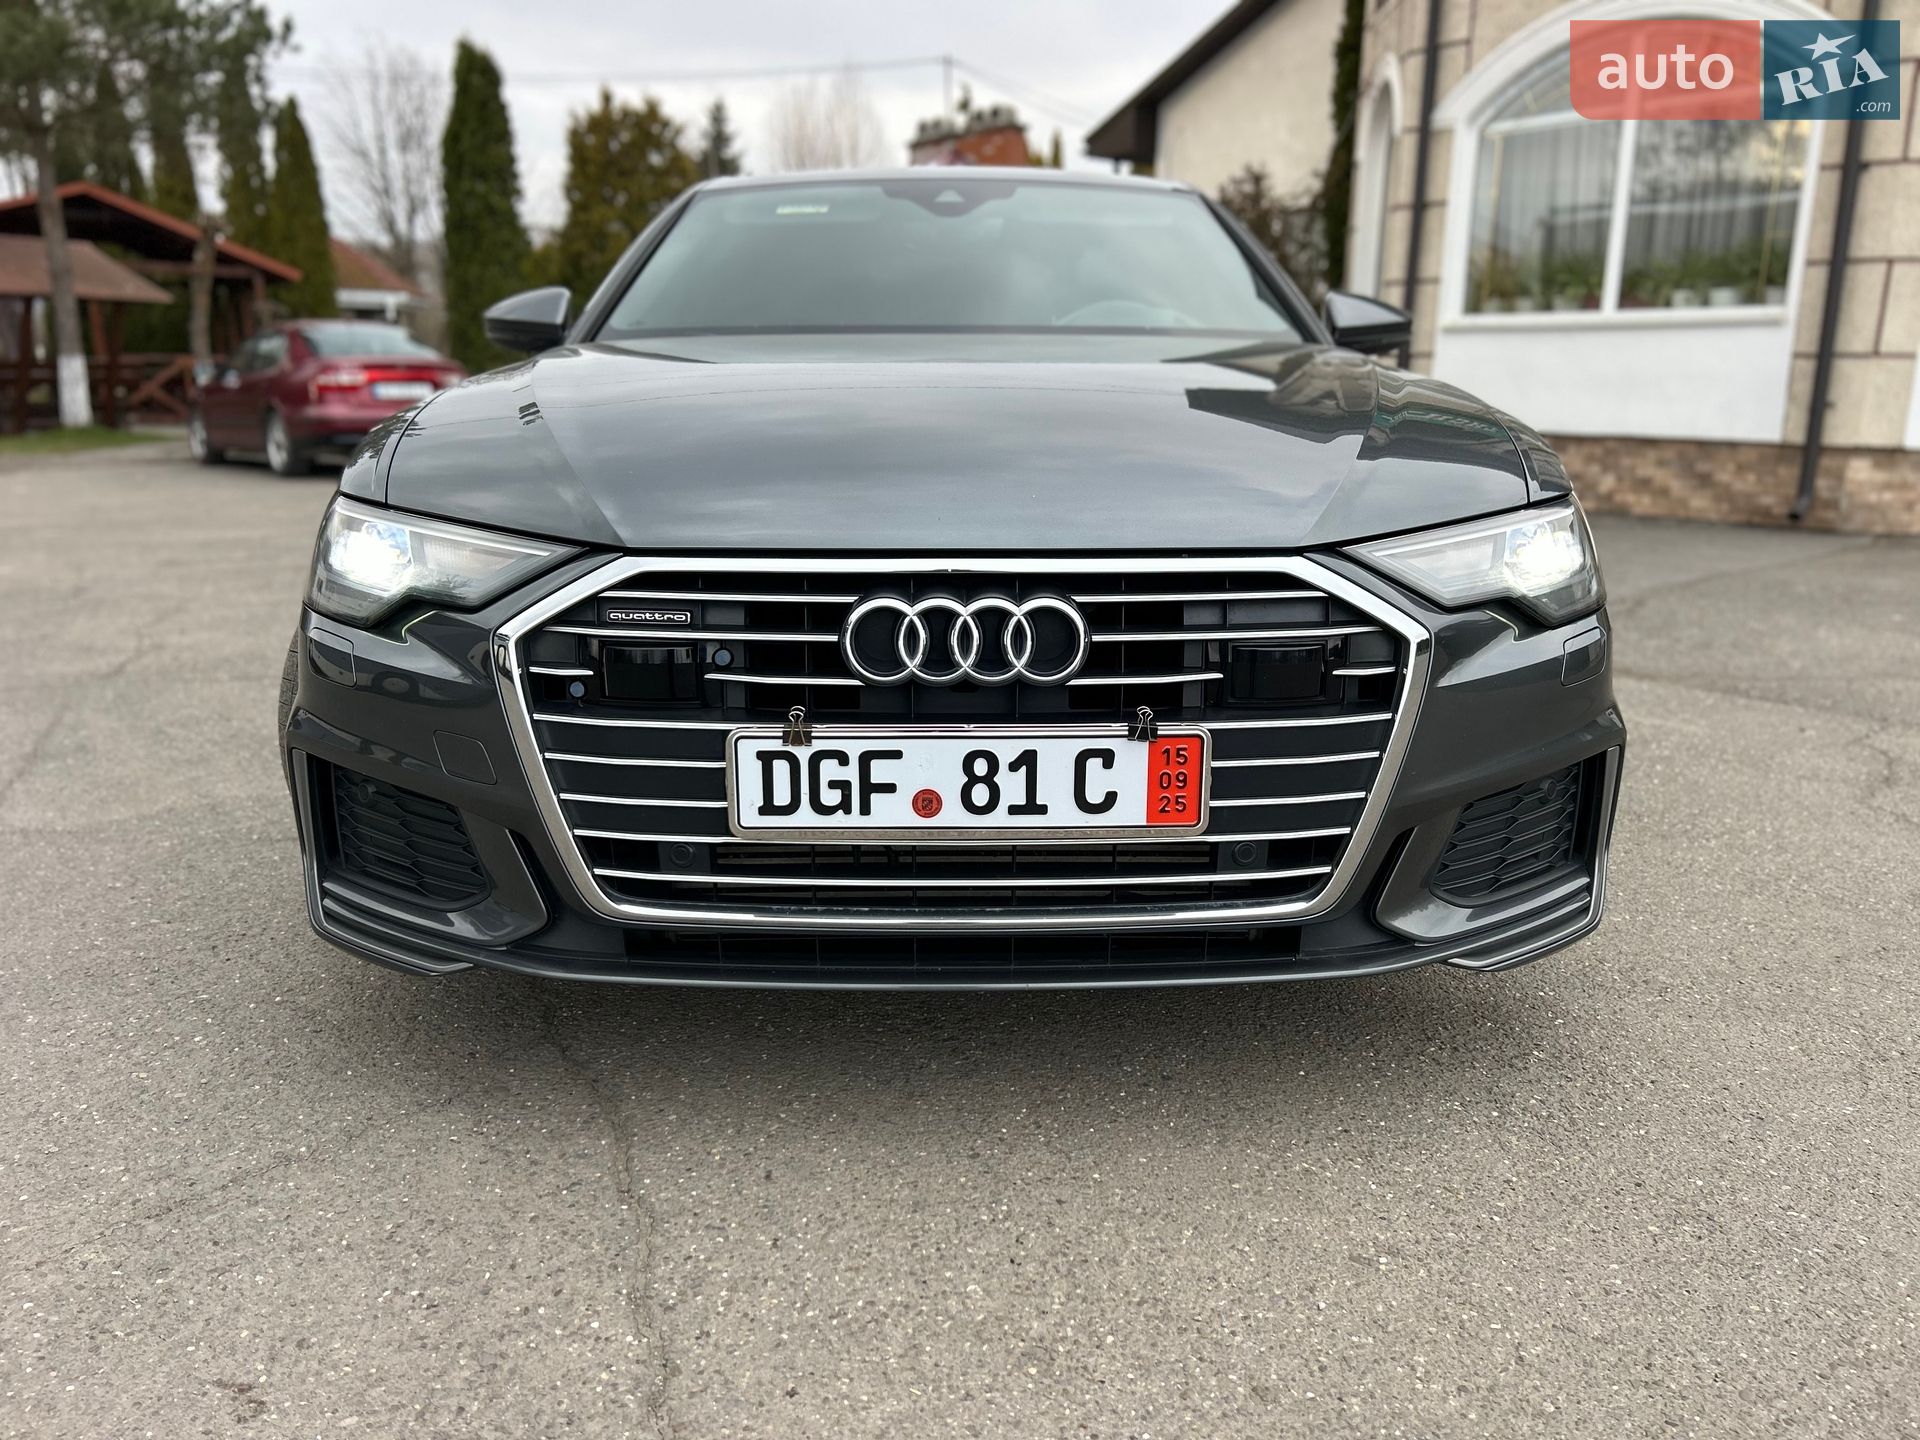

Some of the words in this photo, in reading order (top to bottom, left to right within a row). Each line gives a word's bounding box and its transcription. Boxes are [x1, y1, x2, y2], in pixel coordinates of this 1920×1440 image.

[609, 612, 687, 621] quattro
[1161, 745, 1188, 766] 15
[756, 749, 904, 816] DGF
[960, 749, 1049, 816] 81
[1074, 748, 1119, 815] C
[1160, 770, 1188, 790] 09
[1158, 793, 1187, 814] 25
